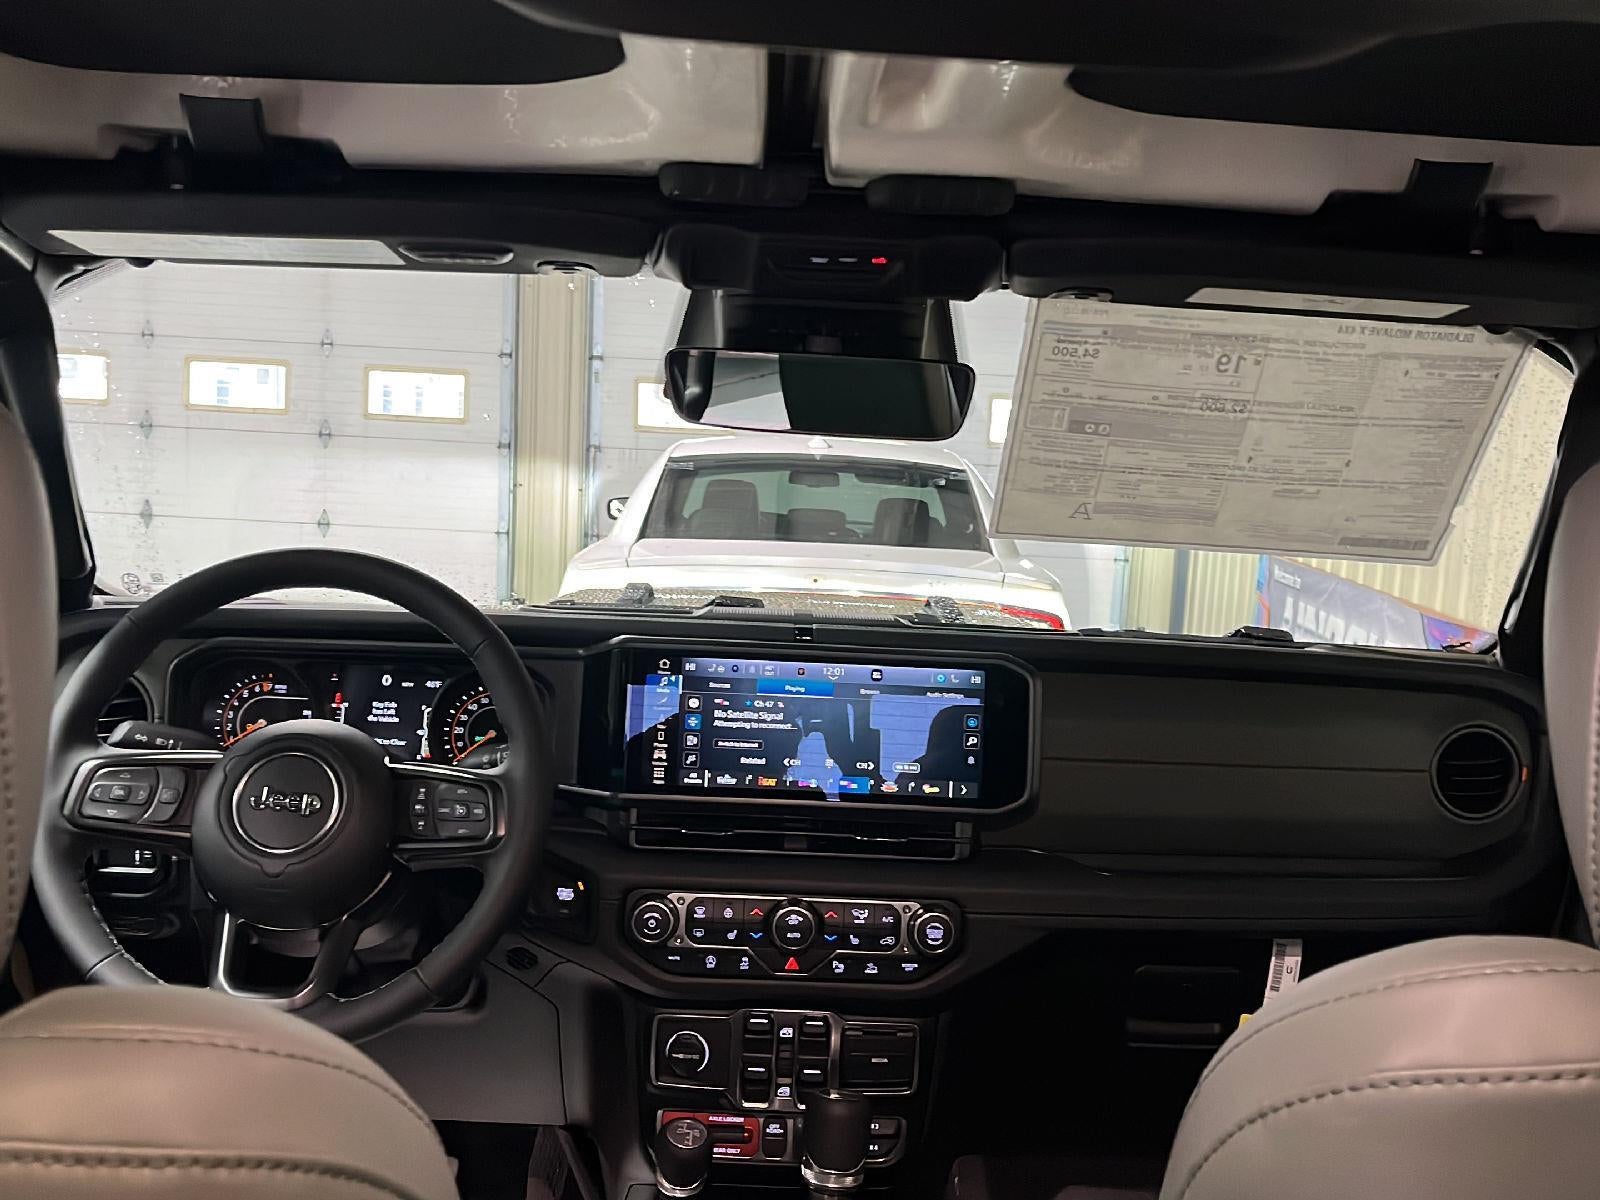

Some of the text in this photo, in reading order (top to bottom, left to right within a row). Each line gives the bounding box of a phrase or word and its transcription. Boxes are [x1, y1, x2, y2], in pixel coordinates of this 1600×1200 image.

[823, 667, 845, 676] 12:01
[713, 710, 784, 721] No Satellite Signal
[453, 726, 464, 734] 20
[713, 719, 751, 730] Attempting
[250, 786, 321, 815] Jeep
